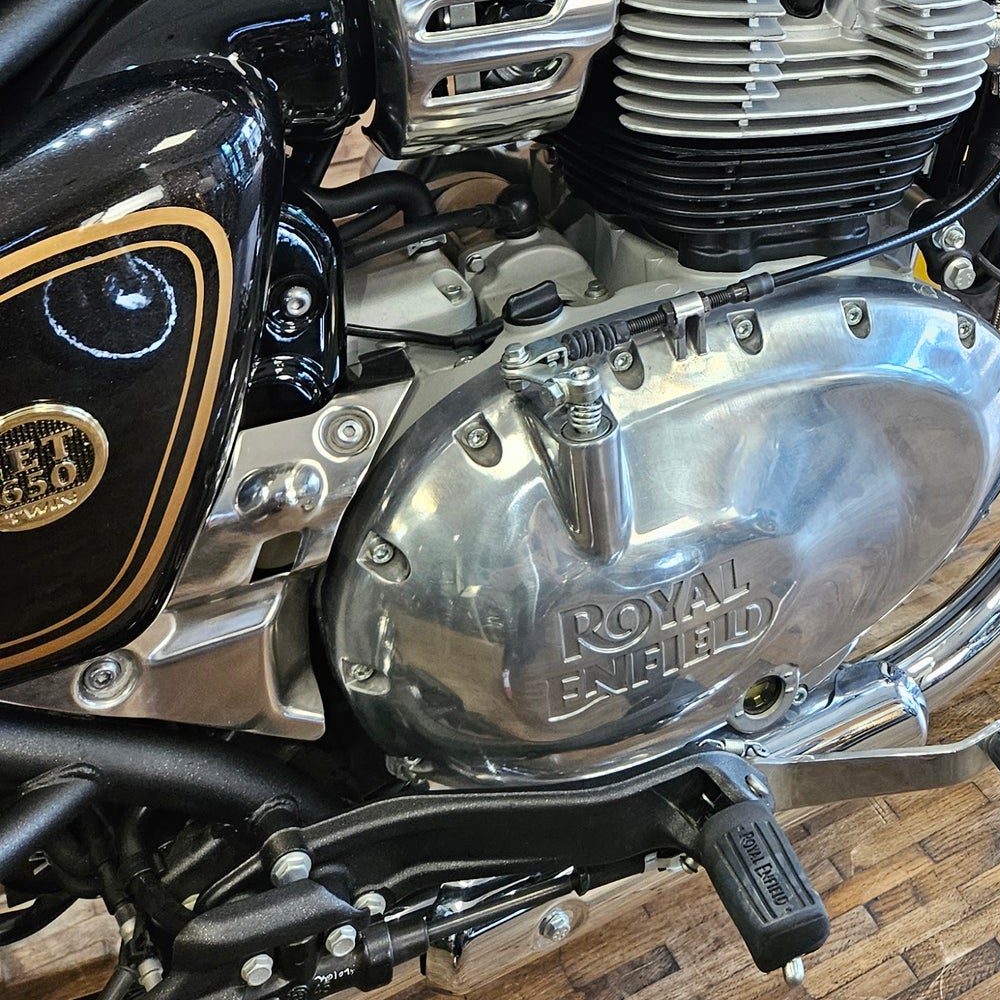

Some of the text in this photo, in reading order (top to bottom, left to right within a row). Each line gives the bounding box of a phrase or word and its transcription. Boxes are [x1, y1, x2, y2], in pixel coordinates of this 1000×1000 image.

[1, 429, 74, 480] ET
[1, 461, 77, 506] 650
[558, 559, 750, 663] ROYAL
[546, 598, 773, 722] ENFIELD
[739, 831, 789, 906] ROYAL ENFIELD
